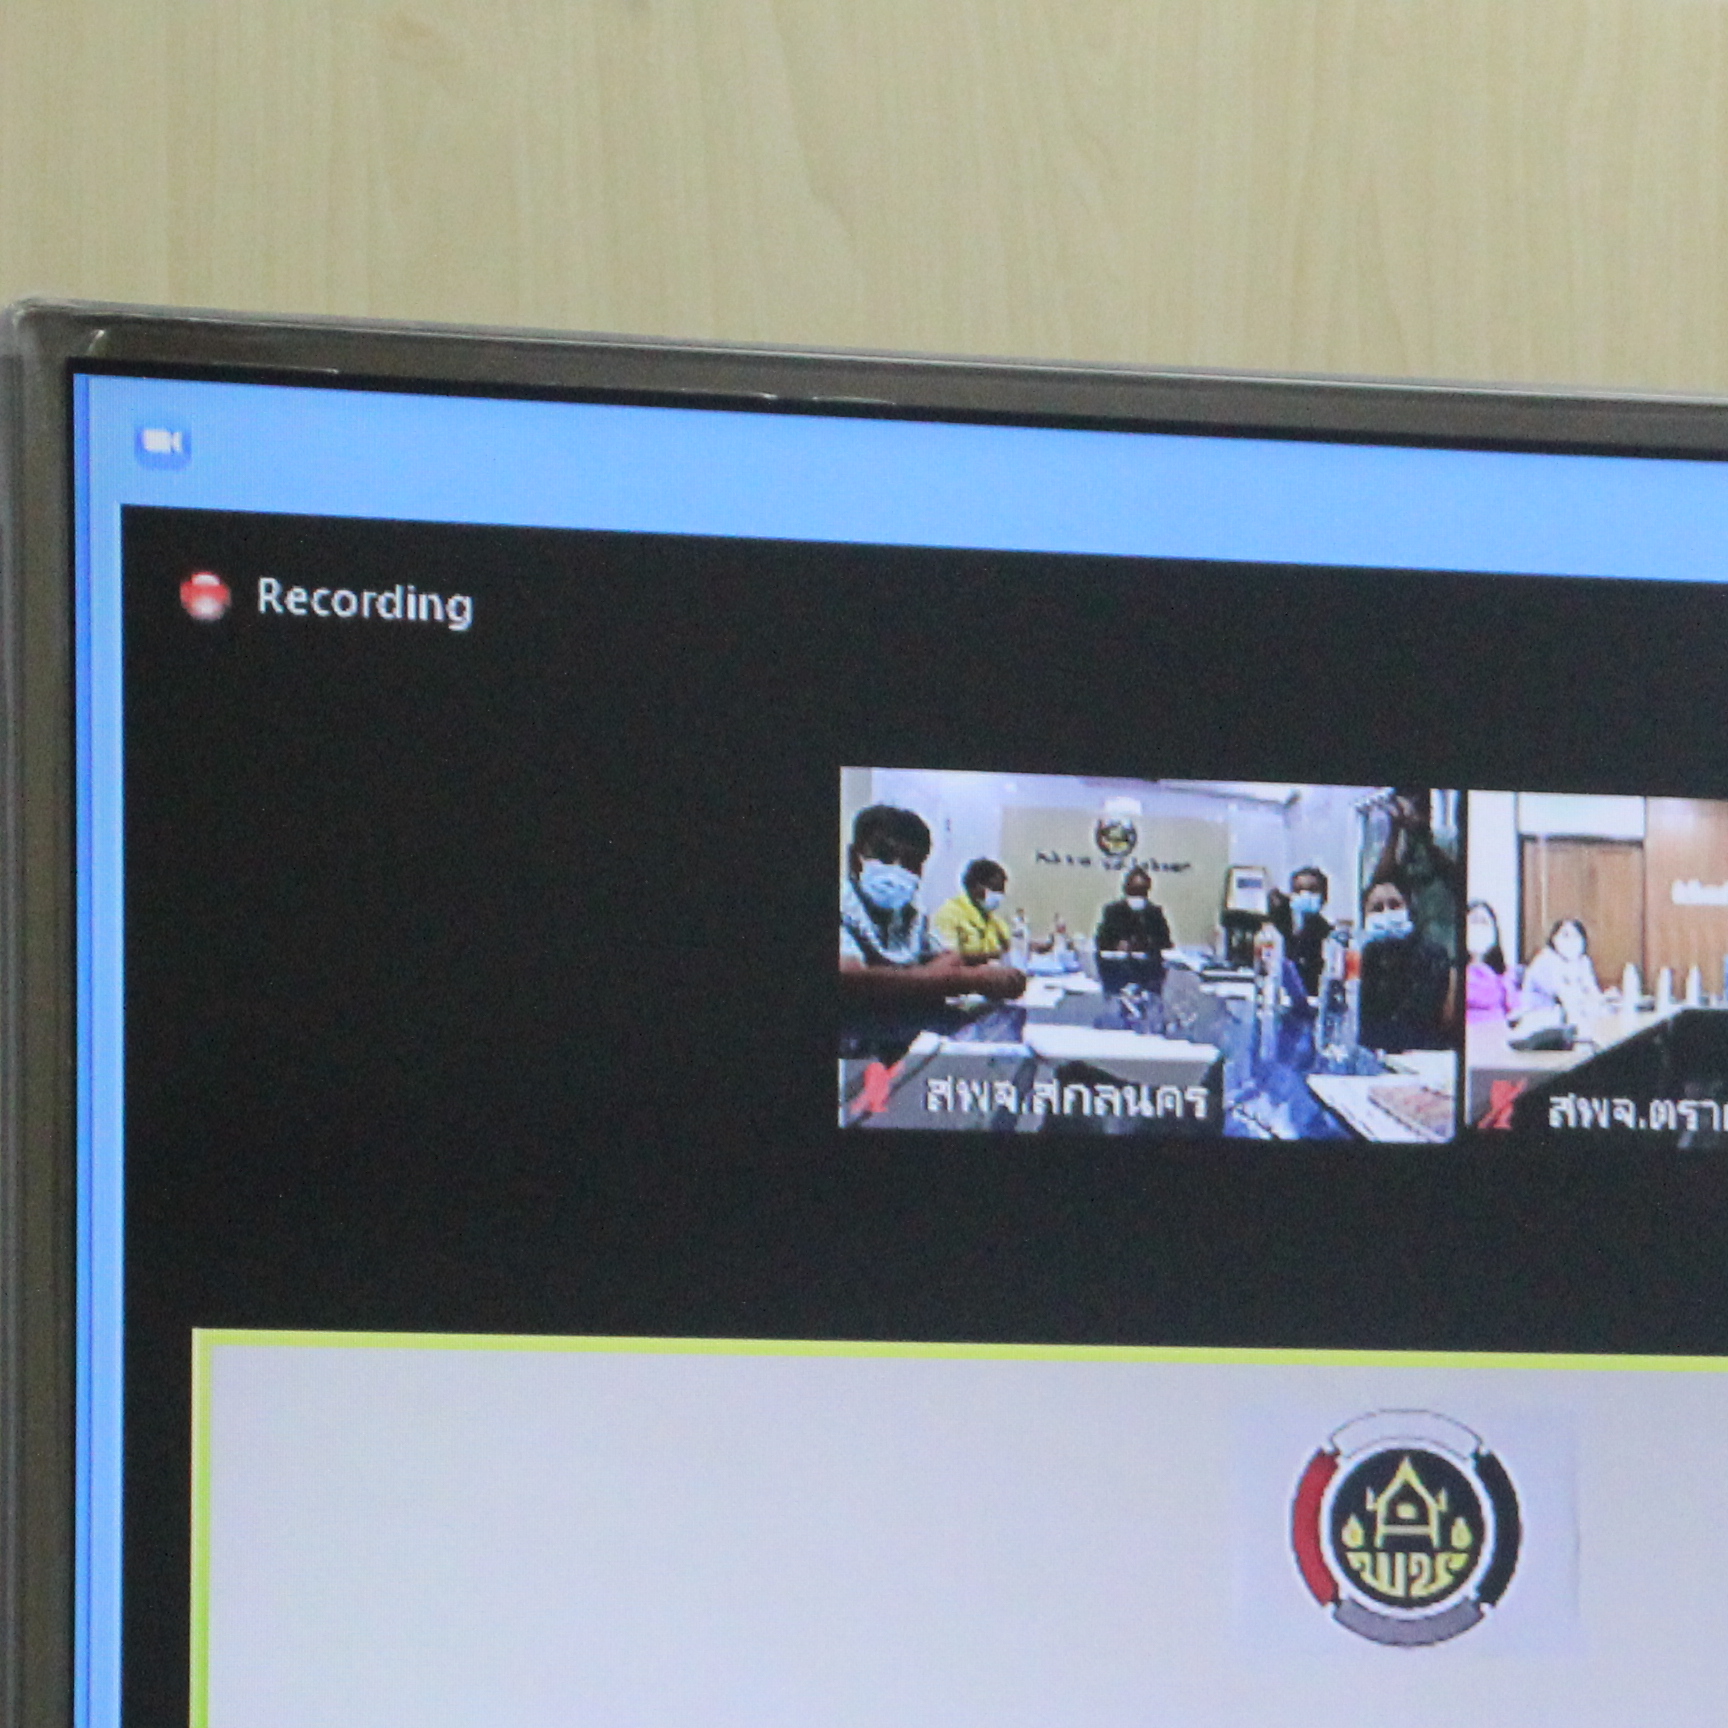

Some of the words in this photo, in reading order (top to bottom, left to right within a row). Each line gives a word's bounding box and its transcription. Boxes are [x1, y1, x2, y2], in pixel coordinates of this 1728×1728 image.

[257, 576, 474, 632] Recording
[926, 1075, 1210, 1118] สพจ.สกลนคร
